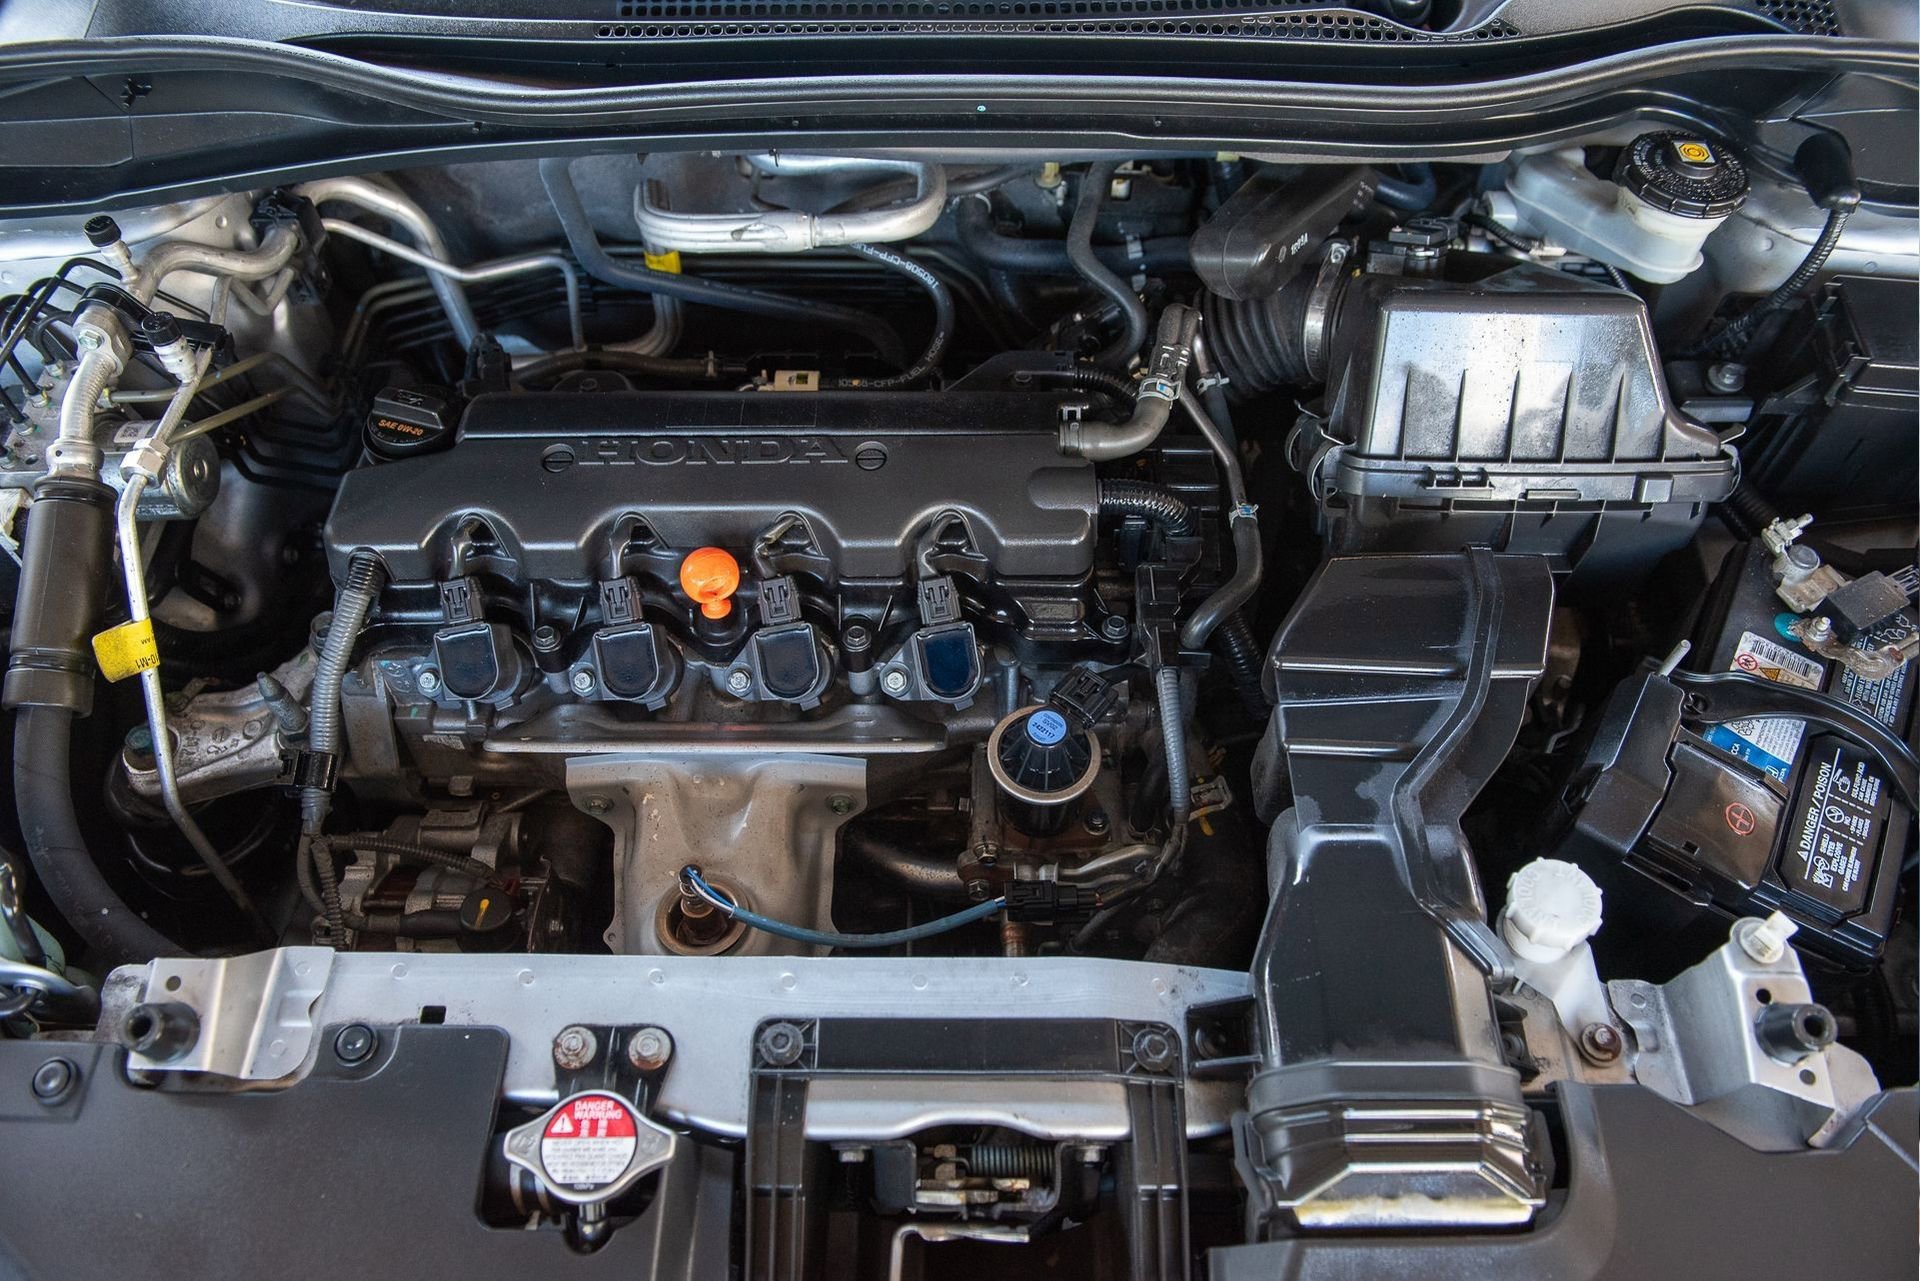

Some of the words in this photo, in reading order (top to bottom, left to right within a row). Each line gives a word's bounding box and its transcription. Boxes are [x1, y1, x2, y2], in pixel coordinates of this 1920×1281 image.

[378, 419, 398, 431] SAE
[397, 423, 424, 437] 0W-20
[579, 440, 848, 465] HONDA
[1801, 808, 1820, 849] DANGER
[1814, 762, 1832, 800] POISON
[574, 1100, 615, 1111] DANGER
